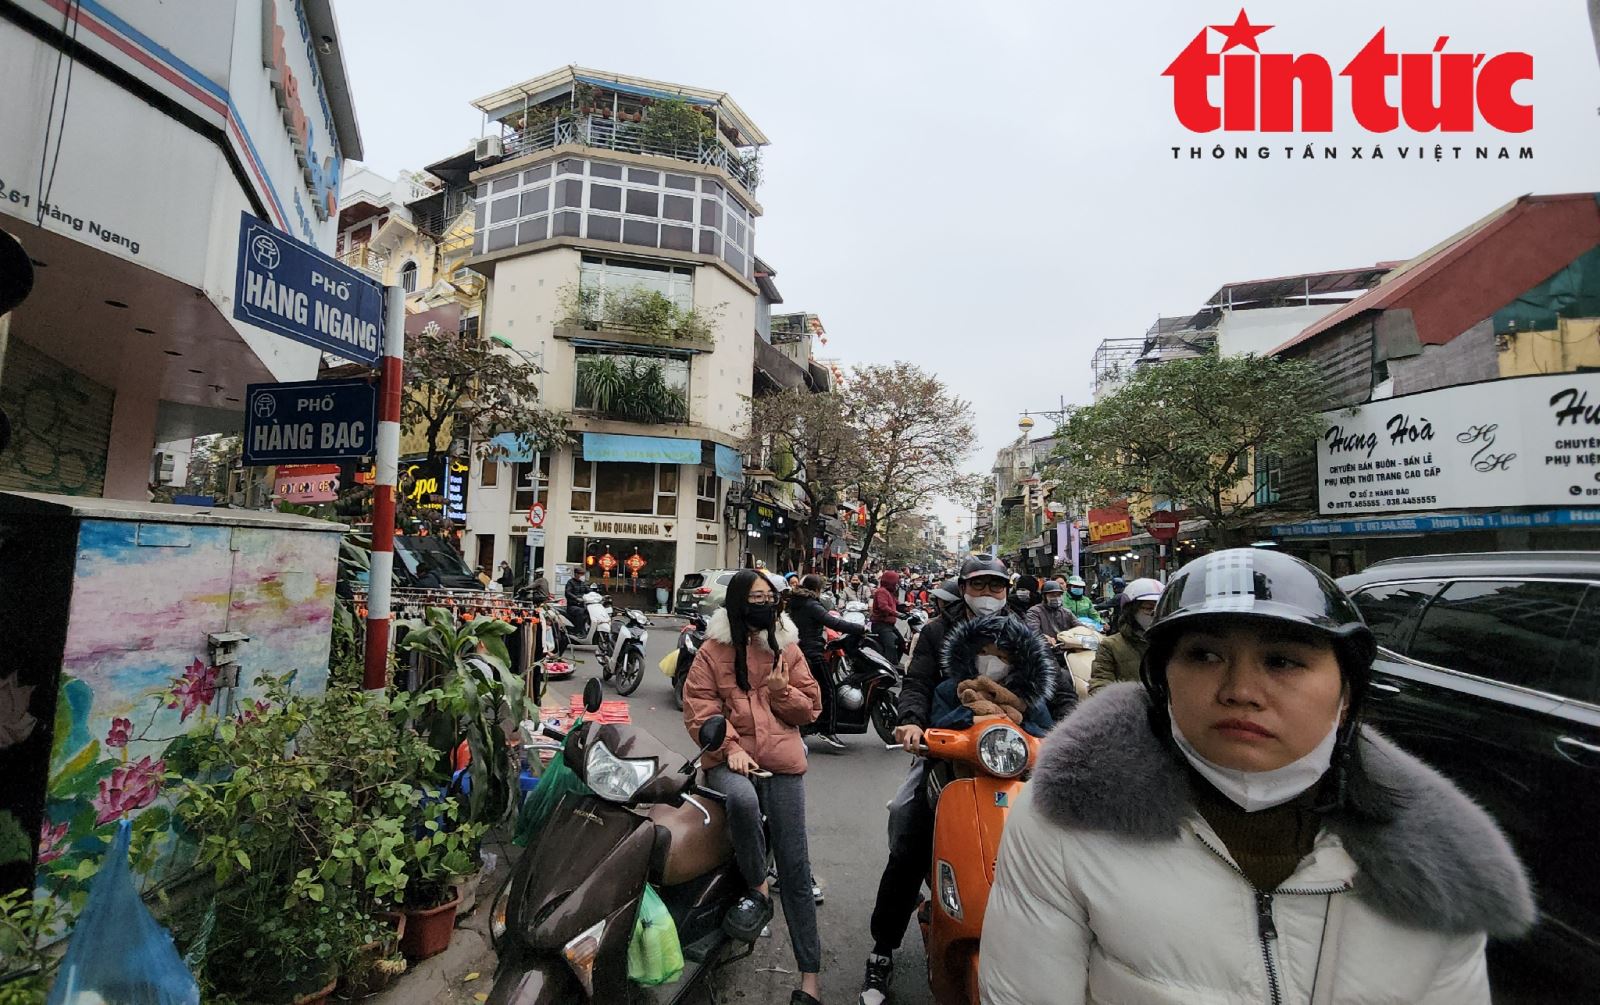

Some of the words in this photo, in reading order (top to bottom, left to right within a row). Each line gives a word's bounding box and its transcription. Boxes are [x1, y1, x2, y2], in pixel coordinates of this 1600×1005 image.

[9, 189, 31, 208] 61
[39, 200, 84, 231] Hàng
[88, 220, 141, 255] Ngang
[311, 270, 352, 301] PHỐ
[246, 269, 309, 325] HÀNG
[314, 299, 378, 353] NGANG
[297, 392, 337, 412] PHỐ
[253, 418, 314, 451] HÀNG
[320, 420, 365, 454] BẠC
[1324, 425, 1379, 459] Hưng
[1375, 459, 1396, 469] BUÔN
[1545, 454, 1571, 467] PHỤ
[1376, 471, 1402, 481] TRANG
[1404, 469, 1421, 479] CAO
[594, 520, 612, 533] VÀNG
[613, 522, 637, 534] QUANG
